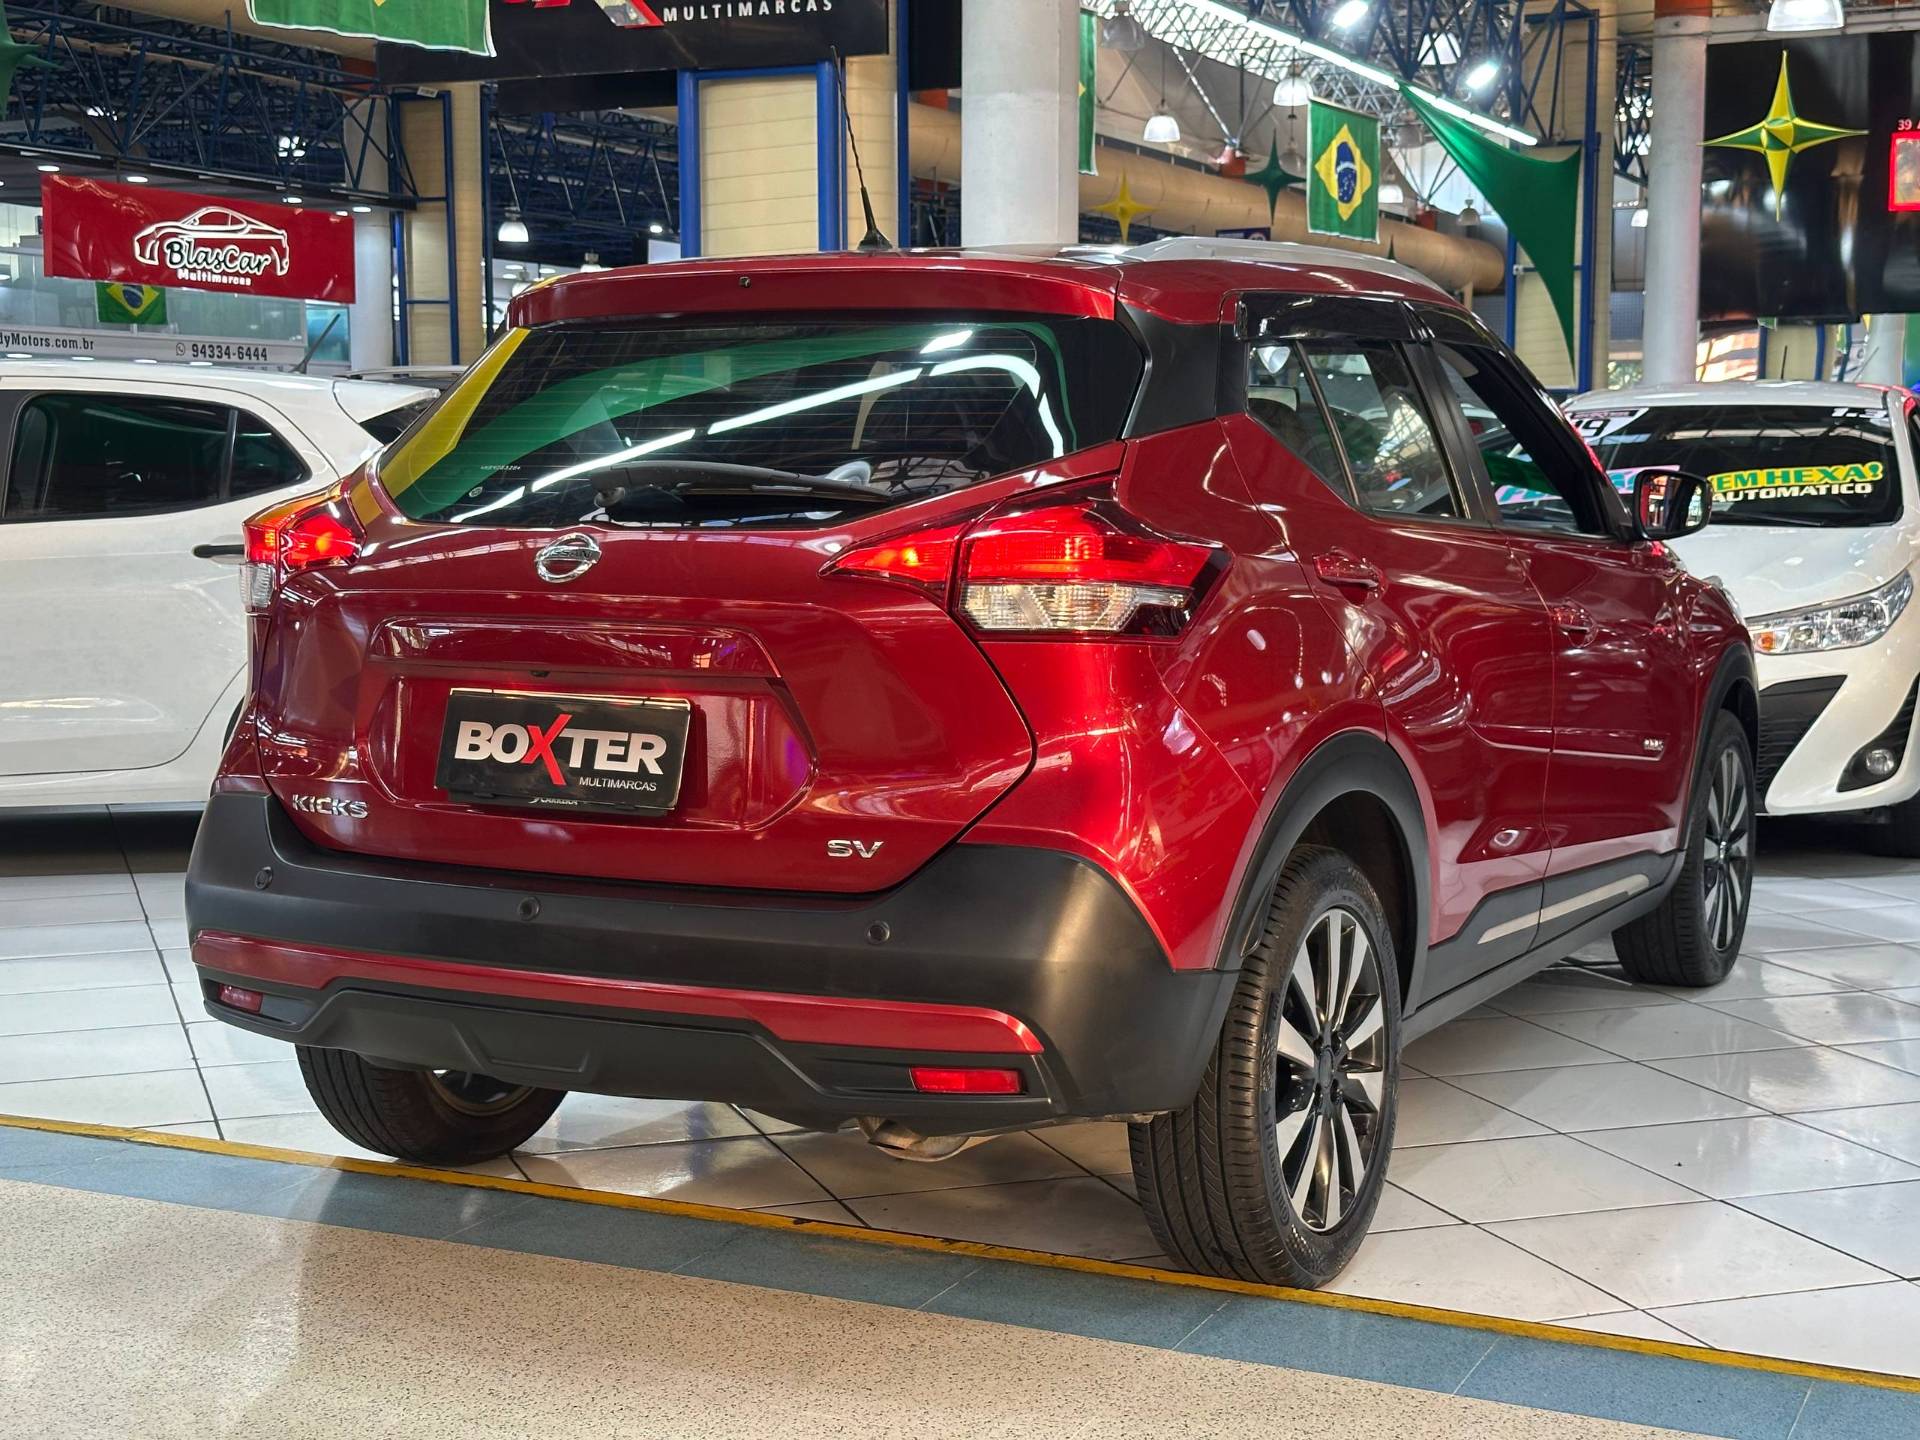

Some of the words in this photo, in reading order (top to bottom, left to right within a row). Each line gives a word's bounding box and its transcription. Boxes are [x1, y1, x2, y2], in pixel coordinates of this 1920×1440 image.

[663, 0, 833, 23] MULTIMARCAS
[164, 237, 270, 275] BlasCar
[177, 269, 252, 286] Multimarcas
[191, 343, 268, 361] 94334-6444
[1765, 463, 1880, 486] HEXA!
[454, 713, 667, 786] BOXTER
[578, 776, 657, 792] MULTIMARCAS
[292, 794, 368, 819] KICKS
[827, 839, 884, 859] SV
